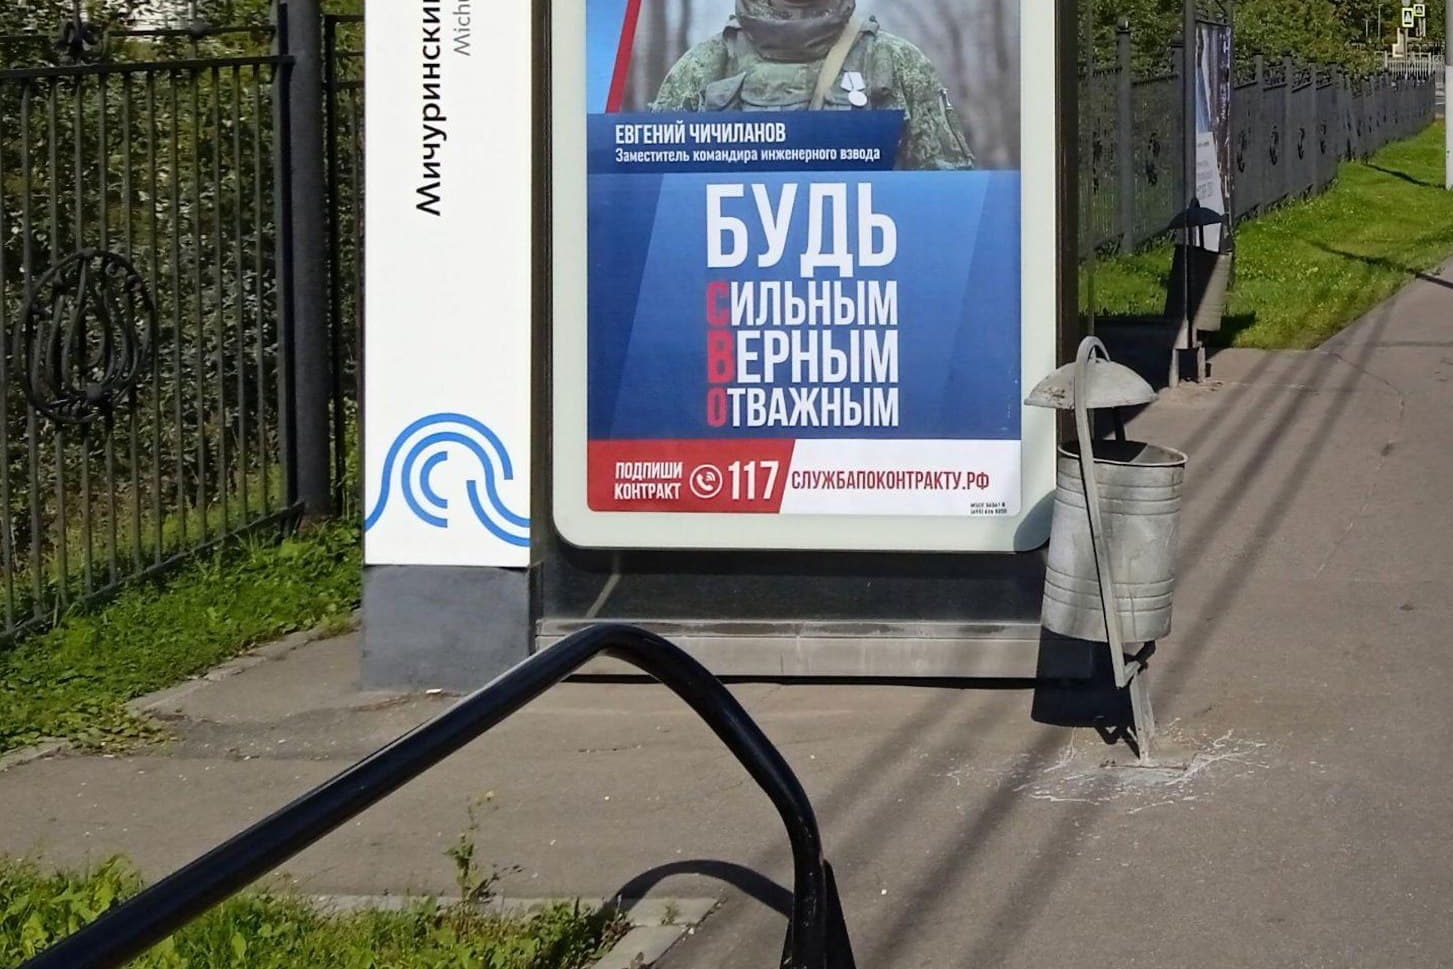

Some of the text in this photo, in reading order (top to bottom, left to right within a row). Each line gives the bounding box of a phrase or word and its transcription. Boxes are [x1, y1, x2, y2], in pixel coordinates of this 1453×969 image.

[615, 121, 786, 144] ЕВГЕНИЙ ЧИЧИЛАНОВ
[615, 148, 881, 163] Заместитель командира инженерного взвода
[706, 182, 897, 278] БУДЬ
[706, 280, 898, 327] СИЛЬНЫМ
[707, 329, 899, 383] ВЕРНЫМ
[707, 387, 899, 427] ОТВАЖНЫМ
[615, 462, 683, 480] ПОДПИШИ
[727, 460, 780, 501] 117
[791, 470, 990, 491] СЛУЖБАПОКОНТРАКТУ.РФ
[614, 482, 682, 501] КОНТРАКТ
